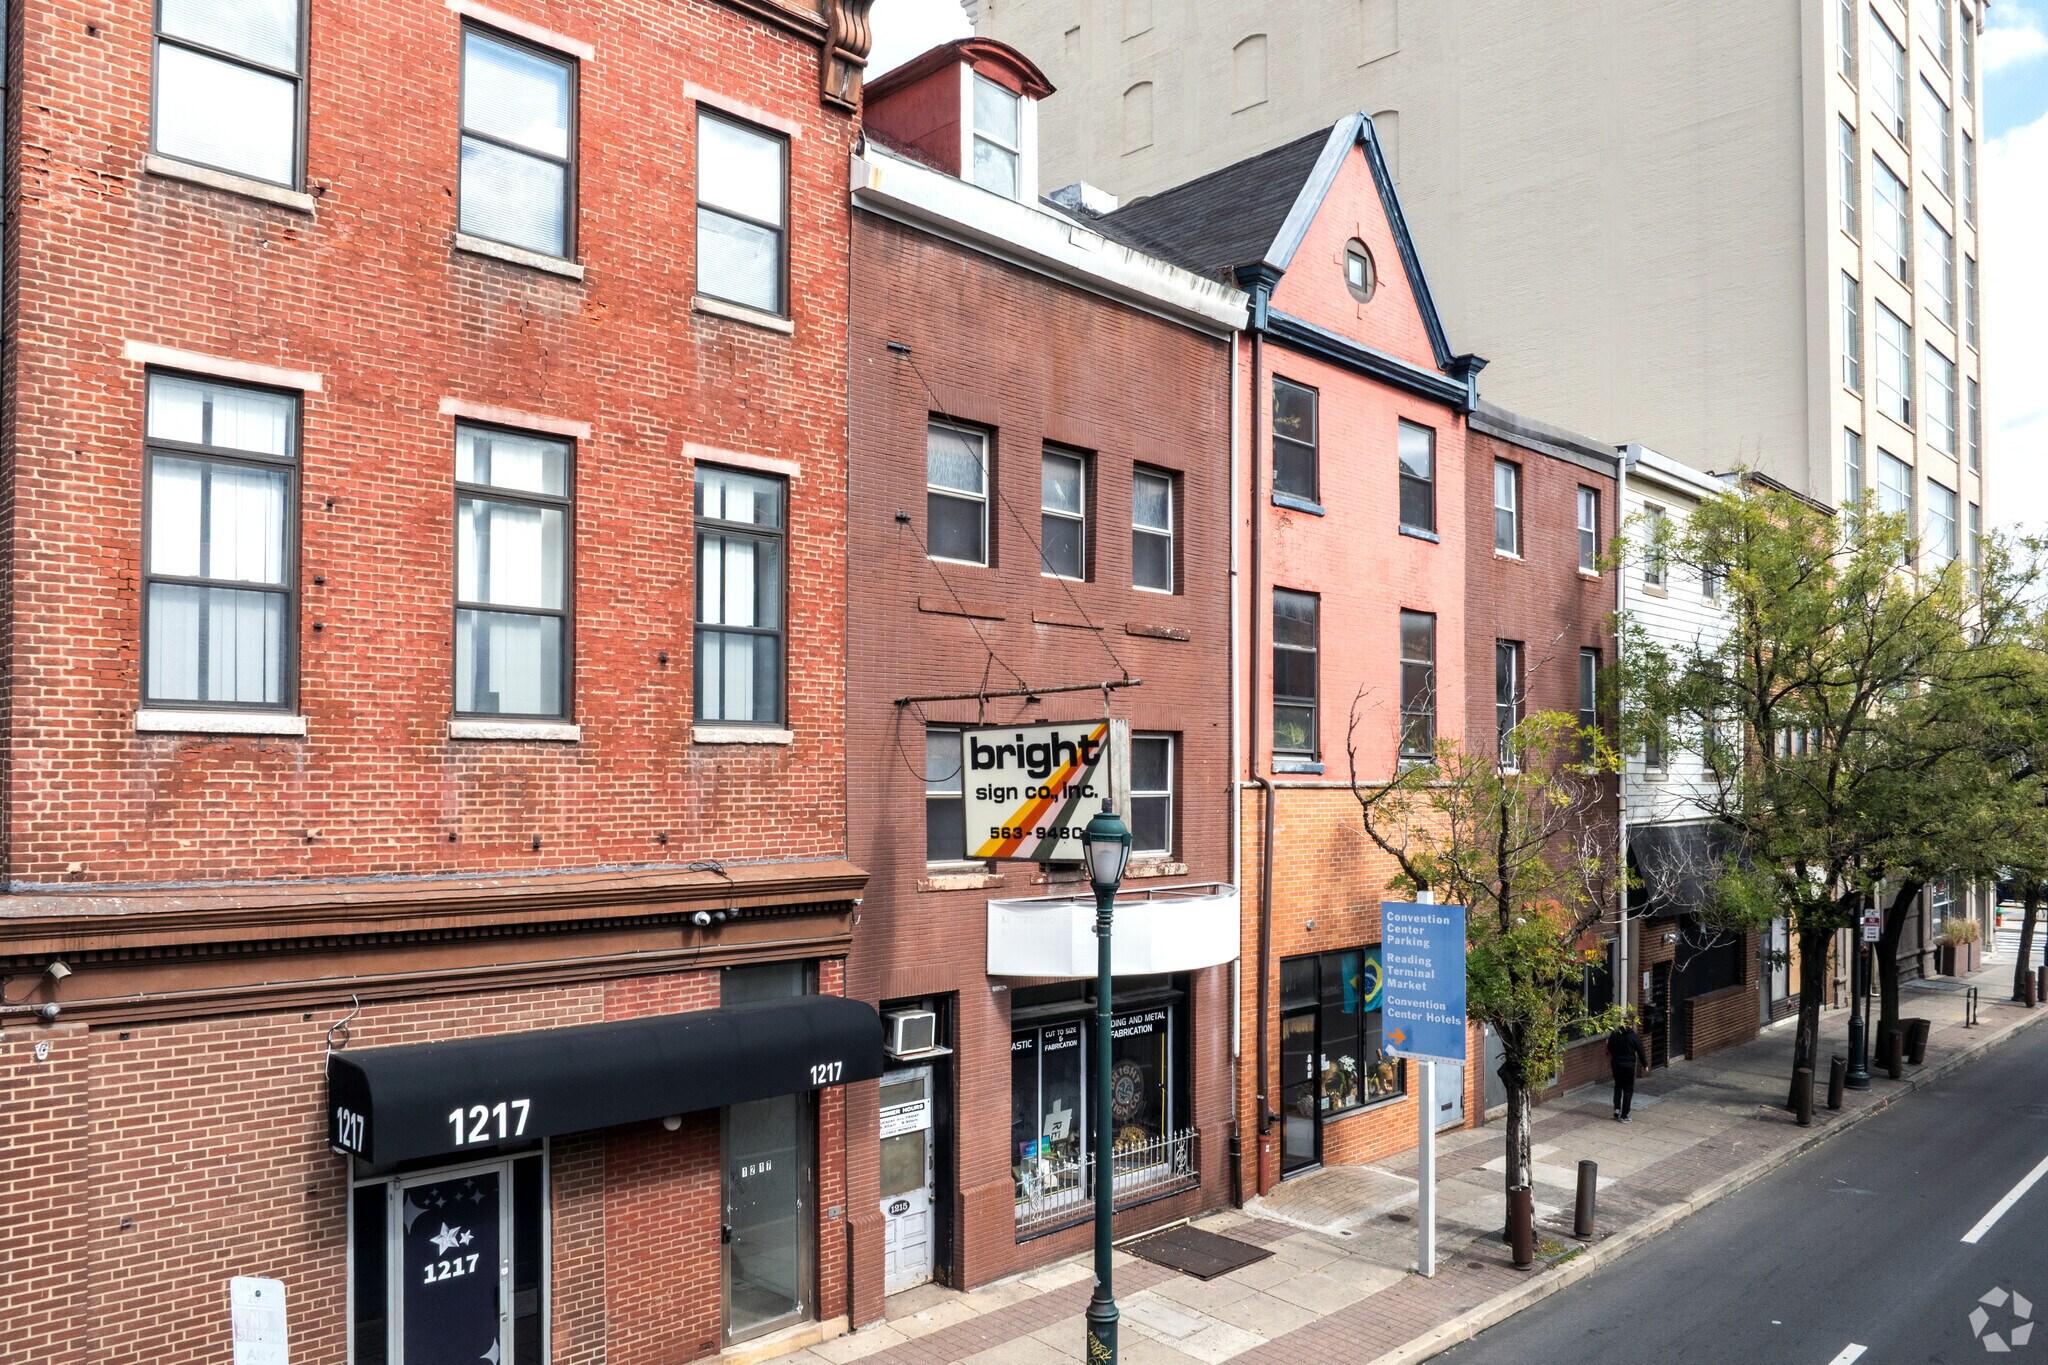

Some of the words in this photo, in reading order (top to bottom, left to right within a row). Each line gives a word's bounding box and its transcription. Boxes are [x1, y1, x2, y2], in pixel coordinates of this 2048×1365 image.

[970, 732, 1100, 779] bright
[976, 784, 1018, 803] sign
[1063, 782, 1098, 799] inc.
[1386, 911, 1450, 925] Convention
[1386, 923, 1425, 935] Center
[1387, 934, 1430, 949] Parking
[1386, 952, 1432, 968] Reading
[1386, 965, 1435, 979] Terminal
[1387, 978, 1427, 991] Market
[1387, 995, 1446, 1011] Convention
[1110, 1018, 1127, 1028] DING
[1128, 1015, 1143, 1025] AND
[1144, 1011, 1165, 1022] METAL
[1387, 1008, 1423, 1021] Center
[1426, 1012, 1462, 1025] Hotels
[1045, 1030, 1056, 1038] CUT
[1057, 1028, 1064, 1036] TO
[1065, 1026, 1077, 1034] SIZE
[1011, 1039, 1033, 1051] ASTIC
[1044, 1039, 1078, 1051] FABRICATION
[810, 1061, 843, 1085] 1217
[902, 1103, 924, 1113] HOURS
[337, 1106, 364, 1152] 1217
[449, 1098, 531, 1145] 1217
[742, 1160, 771, 1178] 1217
[890, 1201, 908, 1214] 1215
[424, 1253, 479, 1284] 1217
[247, 1348, 275, 1361] ANY
